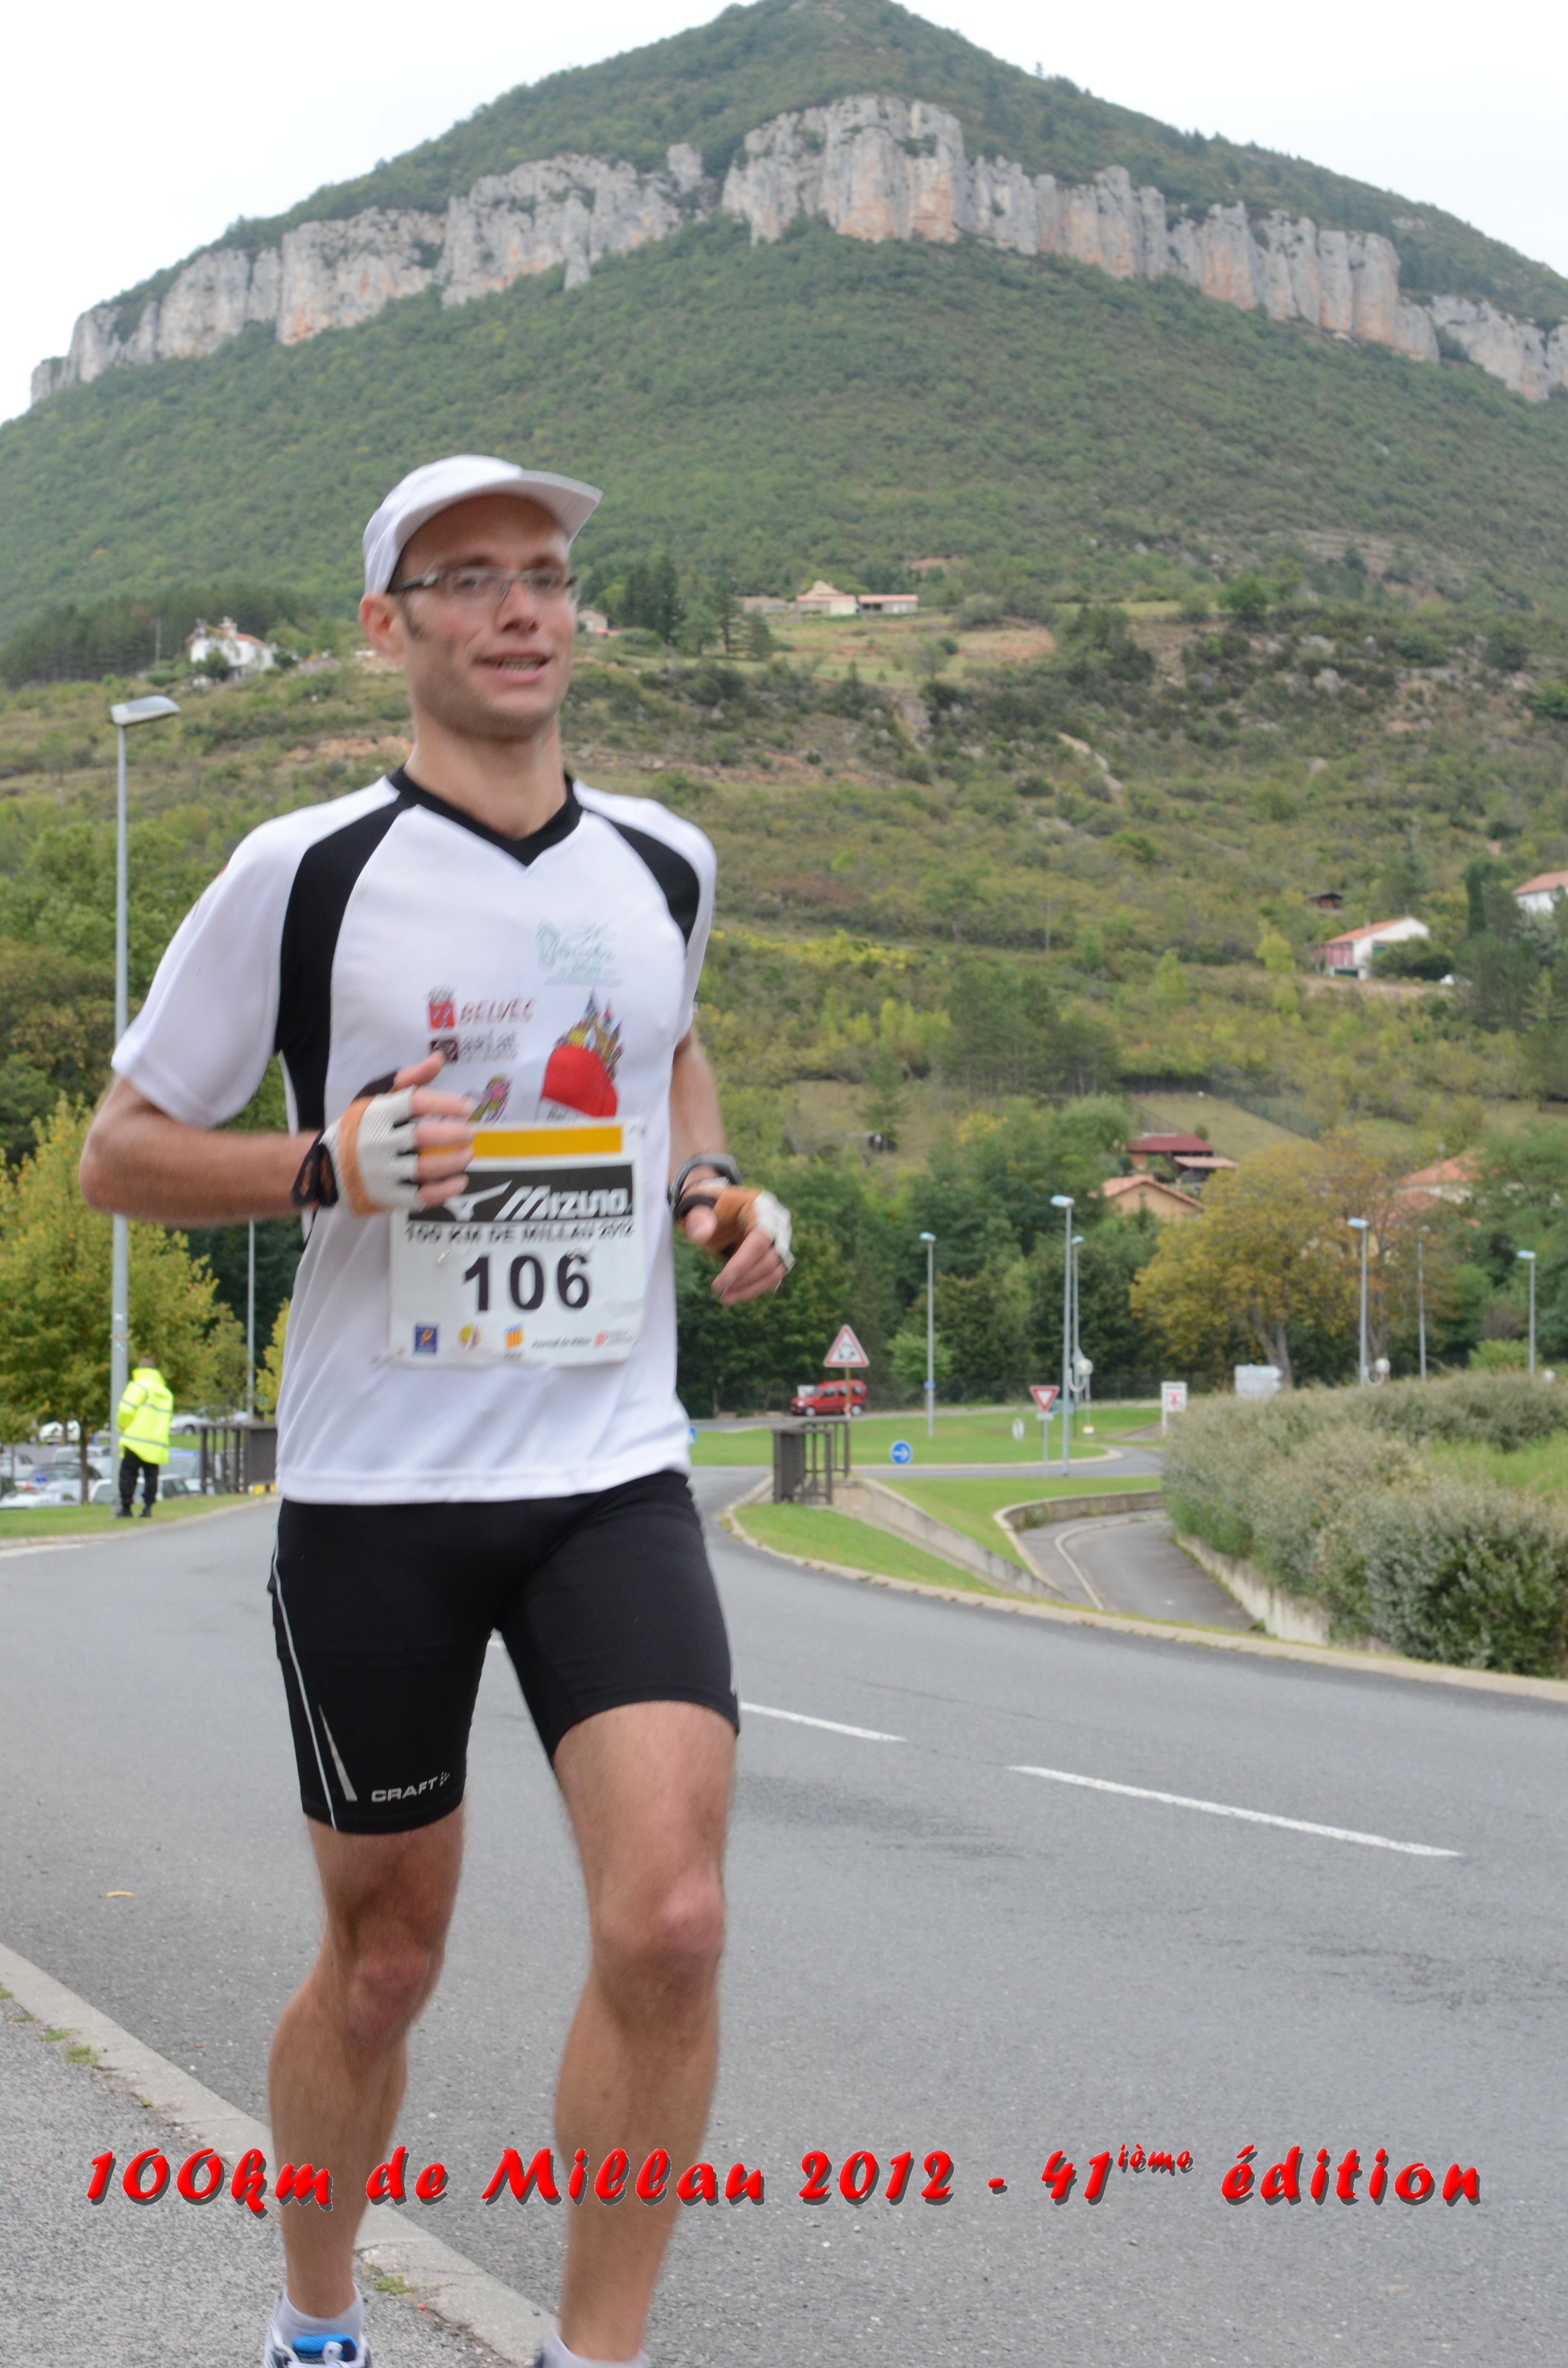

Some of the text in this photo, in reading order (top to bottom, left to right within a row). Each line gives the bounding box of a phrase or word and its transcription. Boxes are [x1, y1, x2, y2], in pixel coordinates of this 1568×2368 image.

[405, 1221, 441, 1244] 100
[448, 1222, 480, 1244] KM
[487, 1222, 518, 1243] DE
[522, 1220, 596, 1243] MILLAU
[463, 1255, 589, 1312] 106
[371, 1776, 438, 1802] CRAFT
